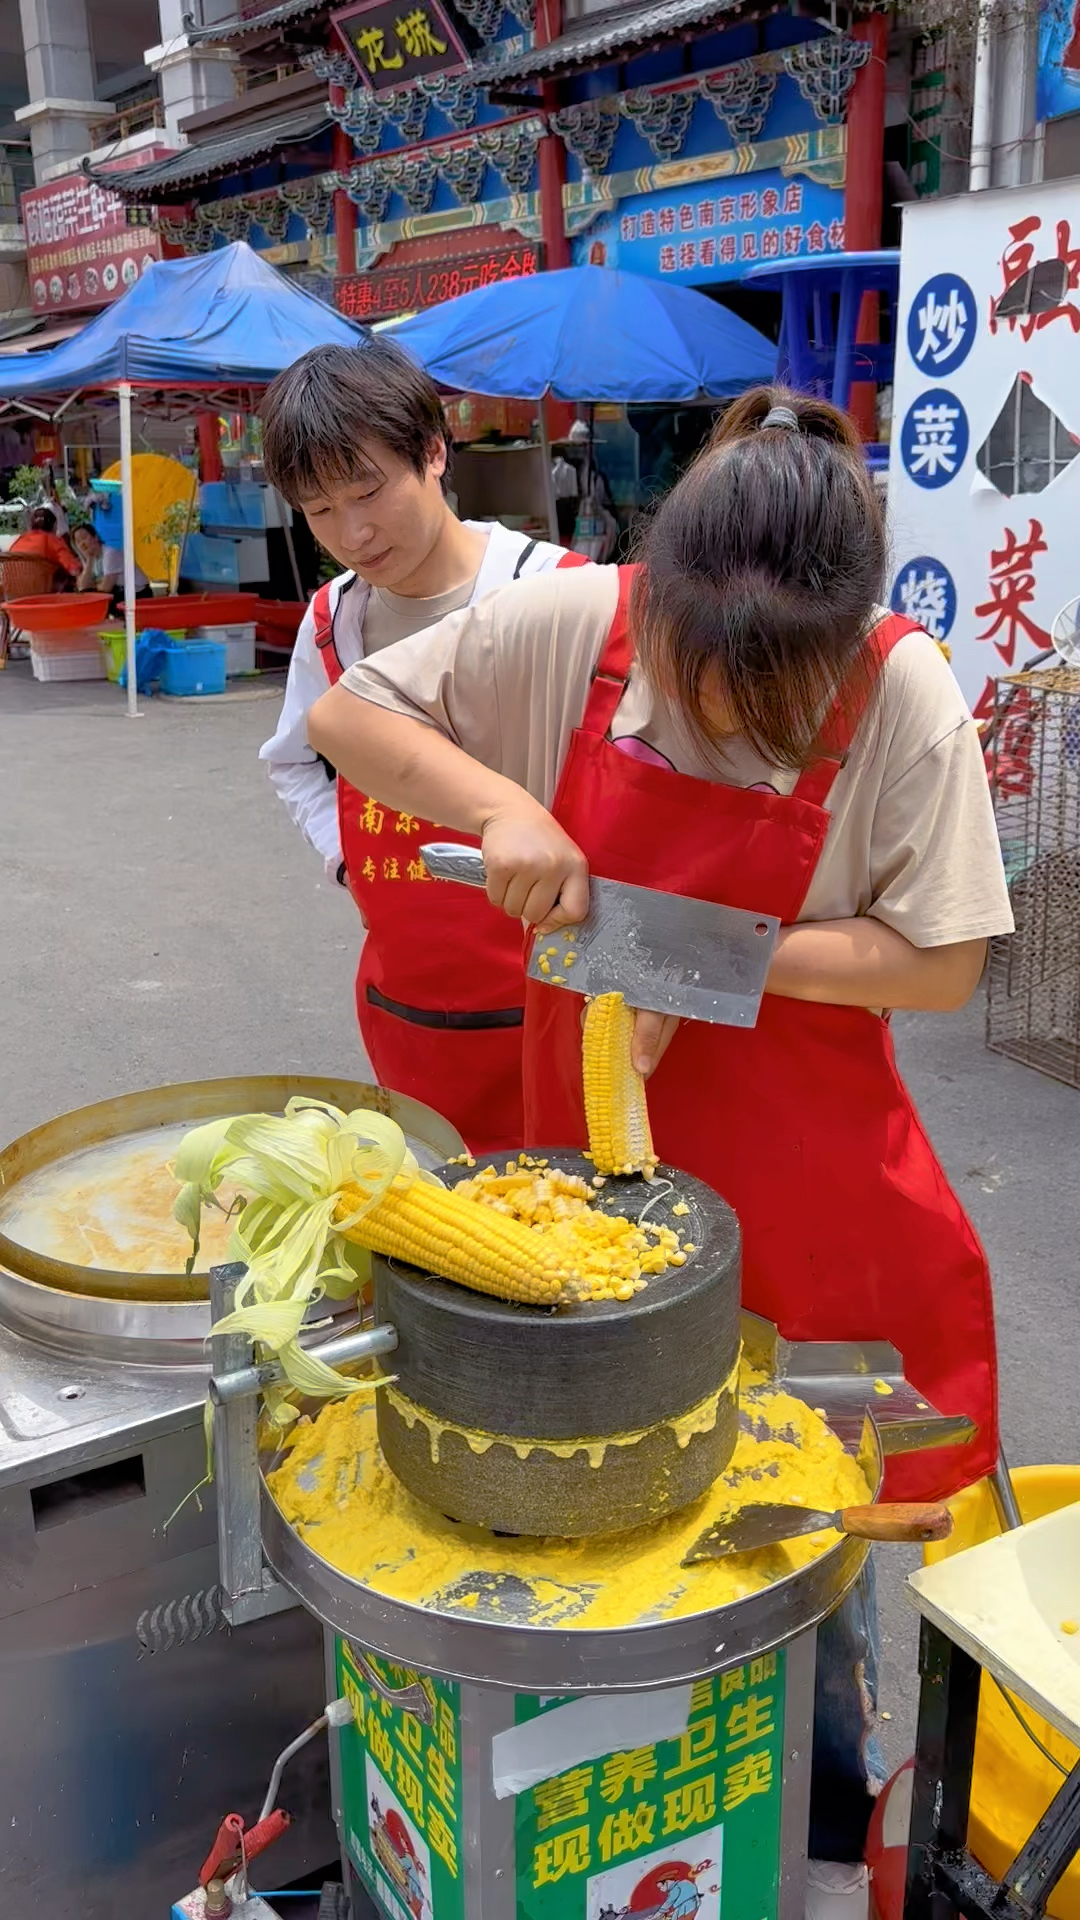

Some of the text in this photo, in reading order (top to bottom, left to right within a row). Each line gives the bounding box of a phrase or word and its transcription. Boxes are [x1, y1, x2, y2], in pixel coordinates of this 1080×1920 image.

[621, 183, 804, 241] 打造特色南京形象店
[659, 217, 846, 274] 选择看得见的好食材
[910, 288, 968, 477] 炒菜
[359, 796, 443, 836] 南京
[361, 855, 449, 884] 专注健
[342, 1664, 458, 1879] 现做现卖
[533, 1693, 776, 1832] 营养卫生
[532, 1750, 774, 1889] 现做现卖
